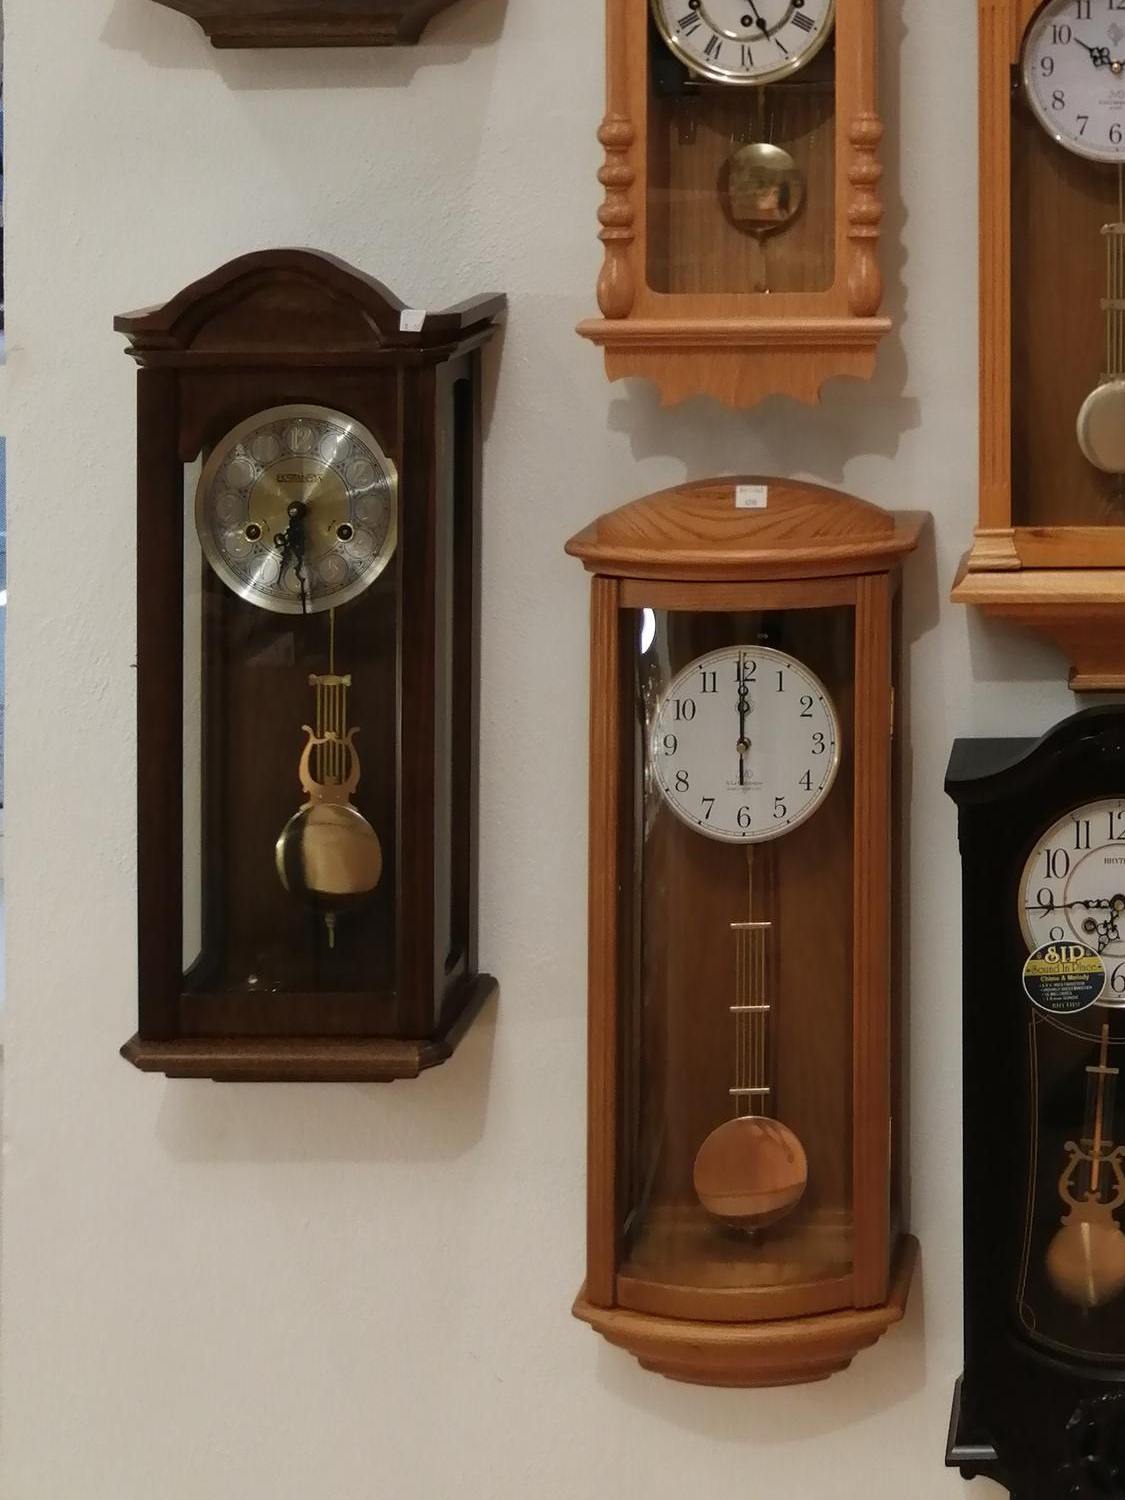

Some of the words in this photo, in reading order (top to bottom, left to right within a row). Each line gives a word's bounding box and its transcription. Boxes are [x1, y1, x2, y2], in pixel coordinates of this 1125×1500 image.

[1075, 0, 1091, 20] 11
[1051, 25, 1072, 45] 10
[1041, 56, 1054, 77] 9
[1051, 90, 1065, 111] 8
[1076, 115, 1089, 136] 7
[1109, 123, 1122, 144] 6
[700, 671, 718, 693] 11
[733, 660, 757, 682] 12
[776, 671, 785, 692] 1
[675, 698, 696, 721] 10
[799, 695, 814, 717] 2
[663, 734, 677, 756] 9
[812, 732, 825, 755] 3
[675, 769, 689, 793] 8
[798, 769, 814, 791] 4
[701, 797, 716, 819] 7
[736, 806, 751, 828] 6
[773, 796, 787, 819] 5
[1074, 820, 1091, 849] 11
[1044, 848, 1070, 879] 10
[1037, 887, 1054, 919] 9
